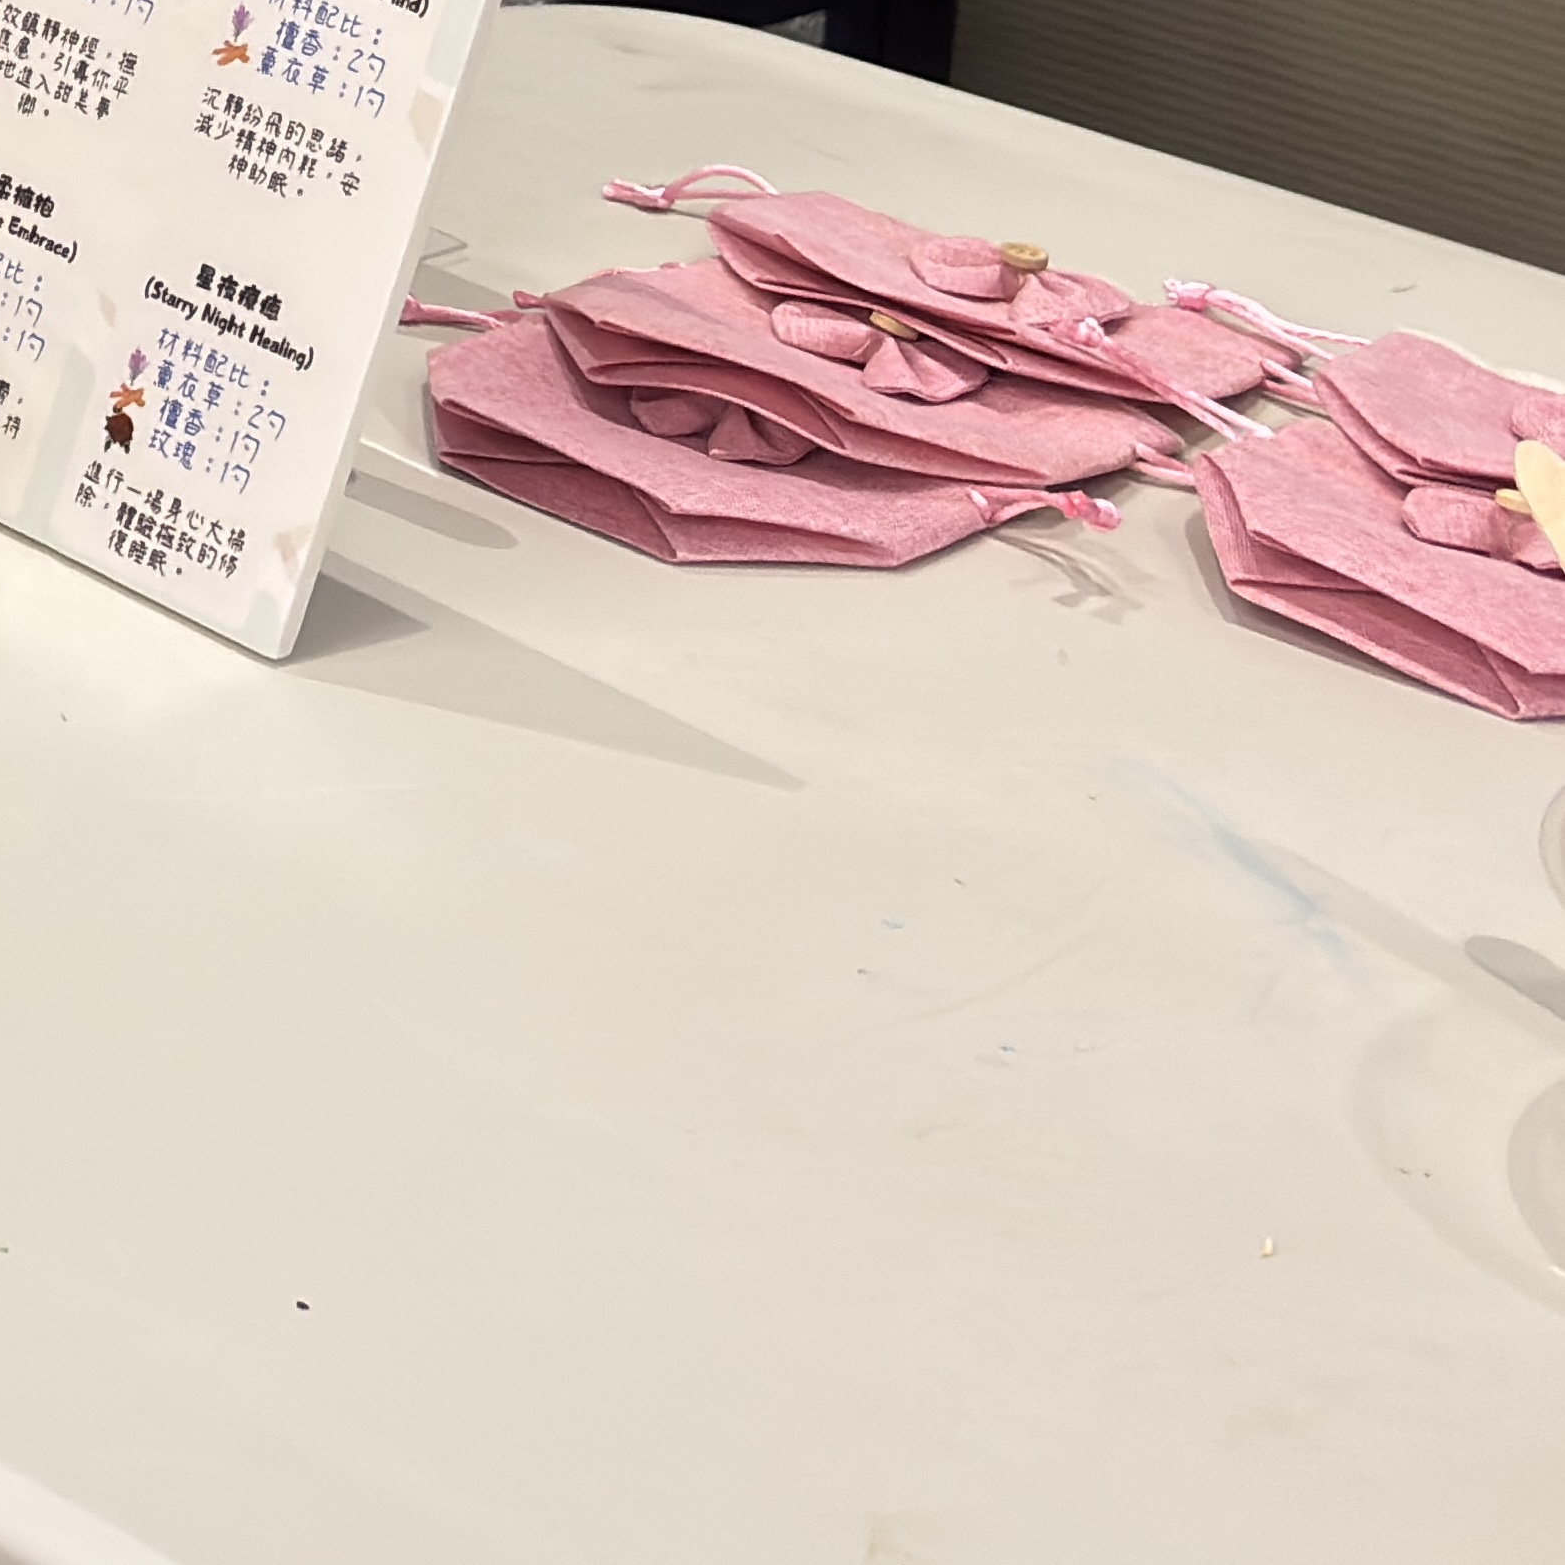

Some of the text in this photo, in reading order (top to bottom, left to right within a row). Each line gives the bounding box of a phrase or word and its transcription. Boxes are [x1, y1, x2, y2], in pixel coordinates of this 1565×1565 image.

[7, 215, 78, 264] Embrace)
[144, 275, 315, 371] (Starry Night Healing)
[157, 327, 270, 397] 材料配比：
